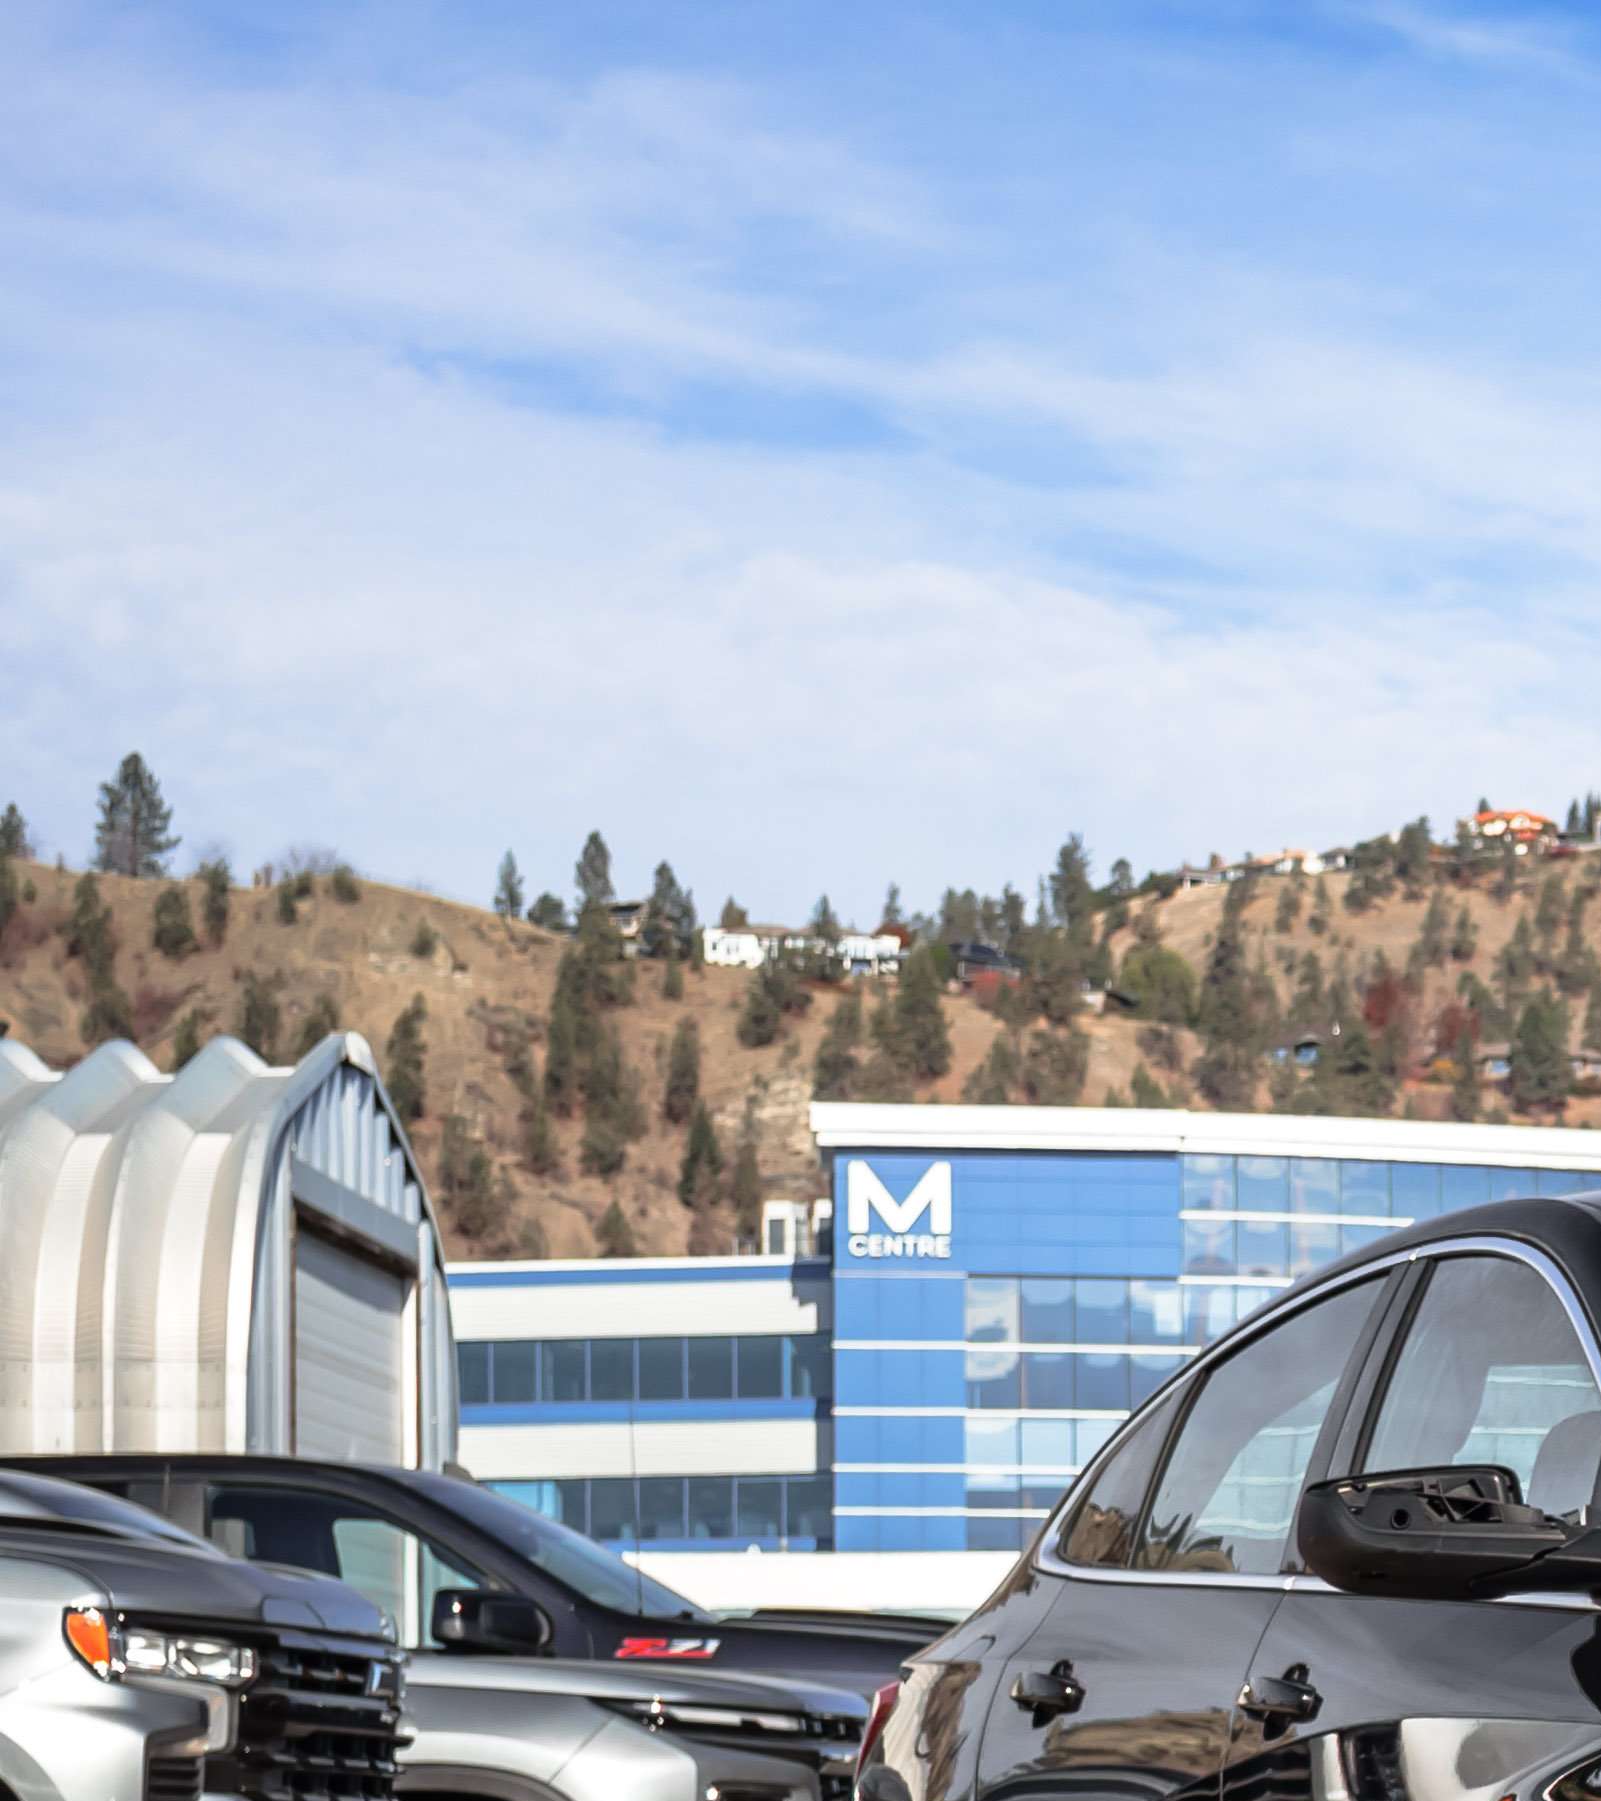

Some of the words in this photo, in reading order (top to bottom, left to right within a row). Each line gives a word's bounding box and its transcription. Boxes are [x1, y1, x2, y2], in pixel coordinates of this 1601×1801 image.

[847, 1159, 952, 1234] M
[847, 1234, 952, 1258] CENTRE
[614, 1637, 721, 1659] Z71
